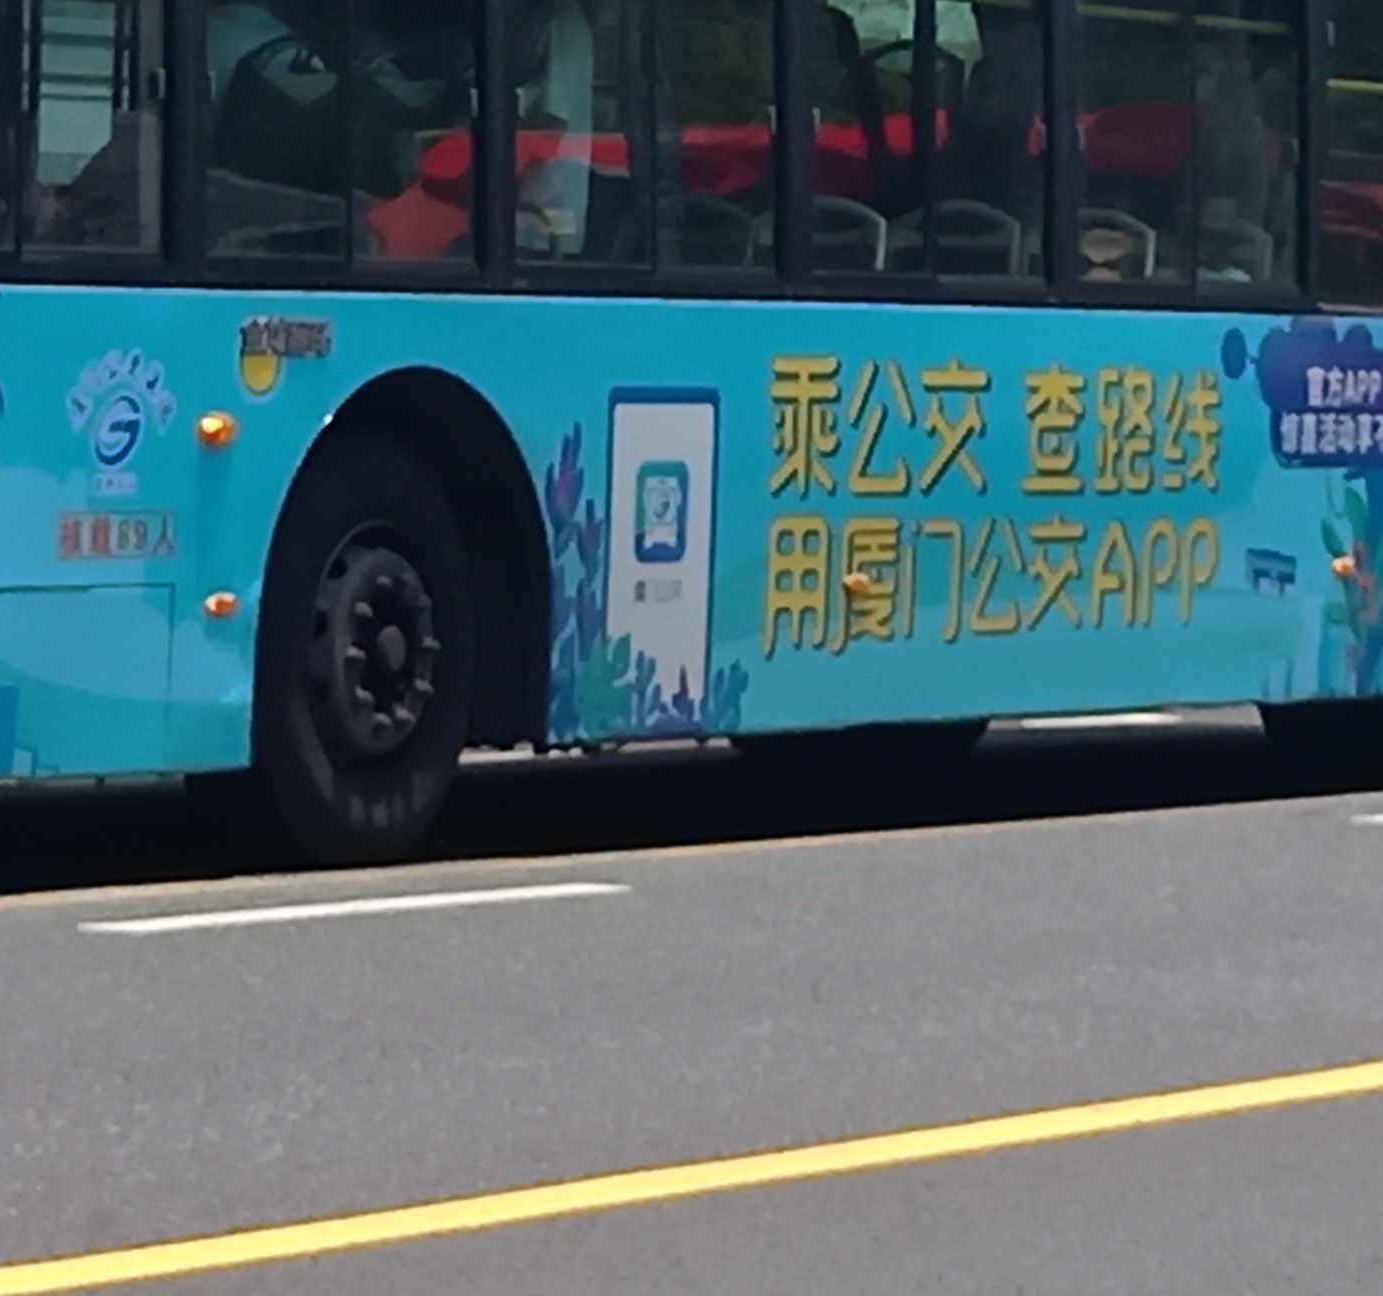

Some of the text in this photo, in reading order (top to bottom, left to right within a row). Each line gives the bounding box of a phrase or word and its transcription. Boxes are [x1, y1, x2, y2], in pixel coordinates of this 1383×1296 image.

[769, 354, 1222, 497] 乘公交 查路线
[762, 514, 1220, 660] 用厦门公交APP
